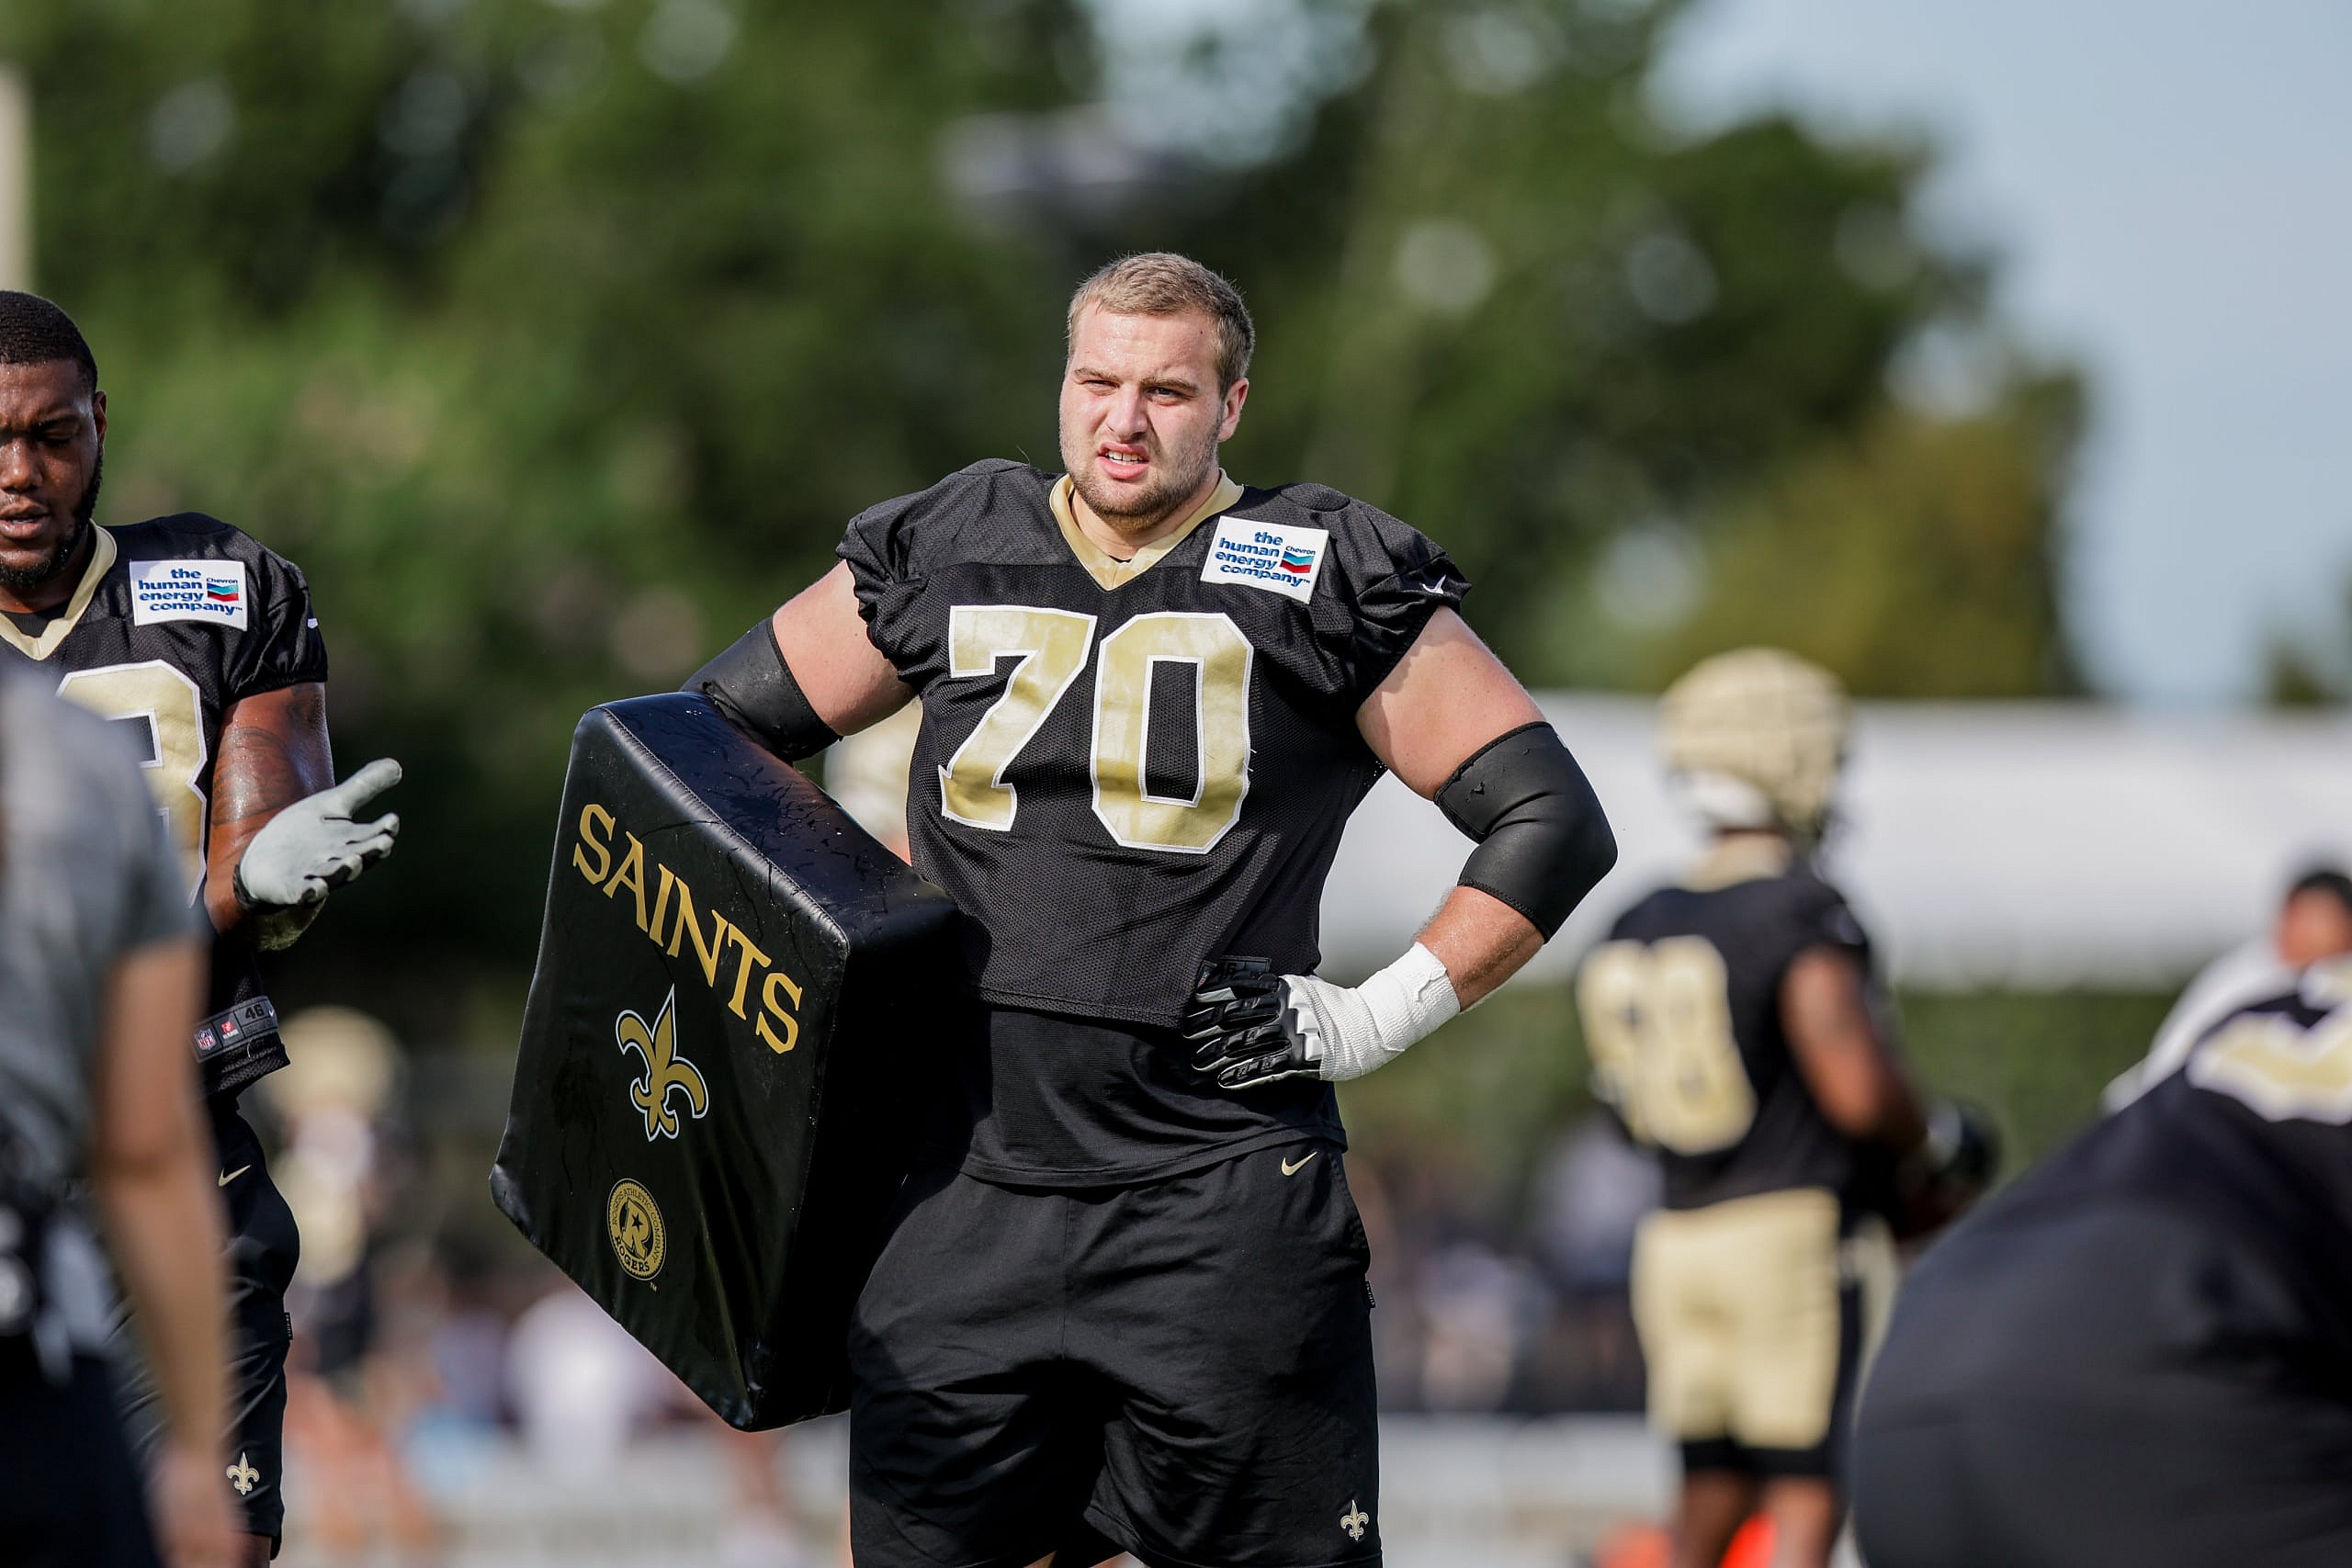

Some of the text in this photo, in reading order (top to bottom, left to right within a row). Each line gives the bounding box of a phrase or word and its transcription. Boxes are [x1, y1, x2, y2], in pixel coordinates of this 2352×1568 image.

[1218, 537, 1280, 558] human
[1254, 532, 1283, 546] the
[1285, 546, 1316, 556] Chevron
[1215, 551, 1278, 570] energy
[171, 568, 201, 579] the
[138, 580, 202, 590] human
[139, 592, 204, 602] energy
[938, 604, 1255, 855] 70
[573, 804, 802, 1055] SAINTS
[245, 1004, 265, 1020] 46
[624, 1188, 652, 1210] ATHLETIC
[650, 1212, 661, 1263] COMPANY
[615, 1235, 650, 1272] ROGERS
